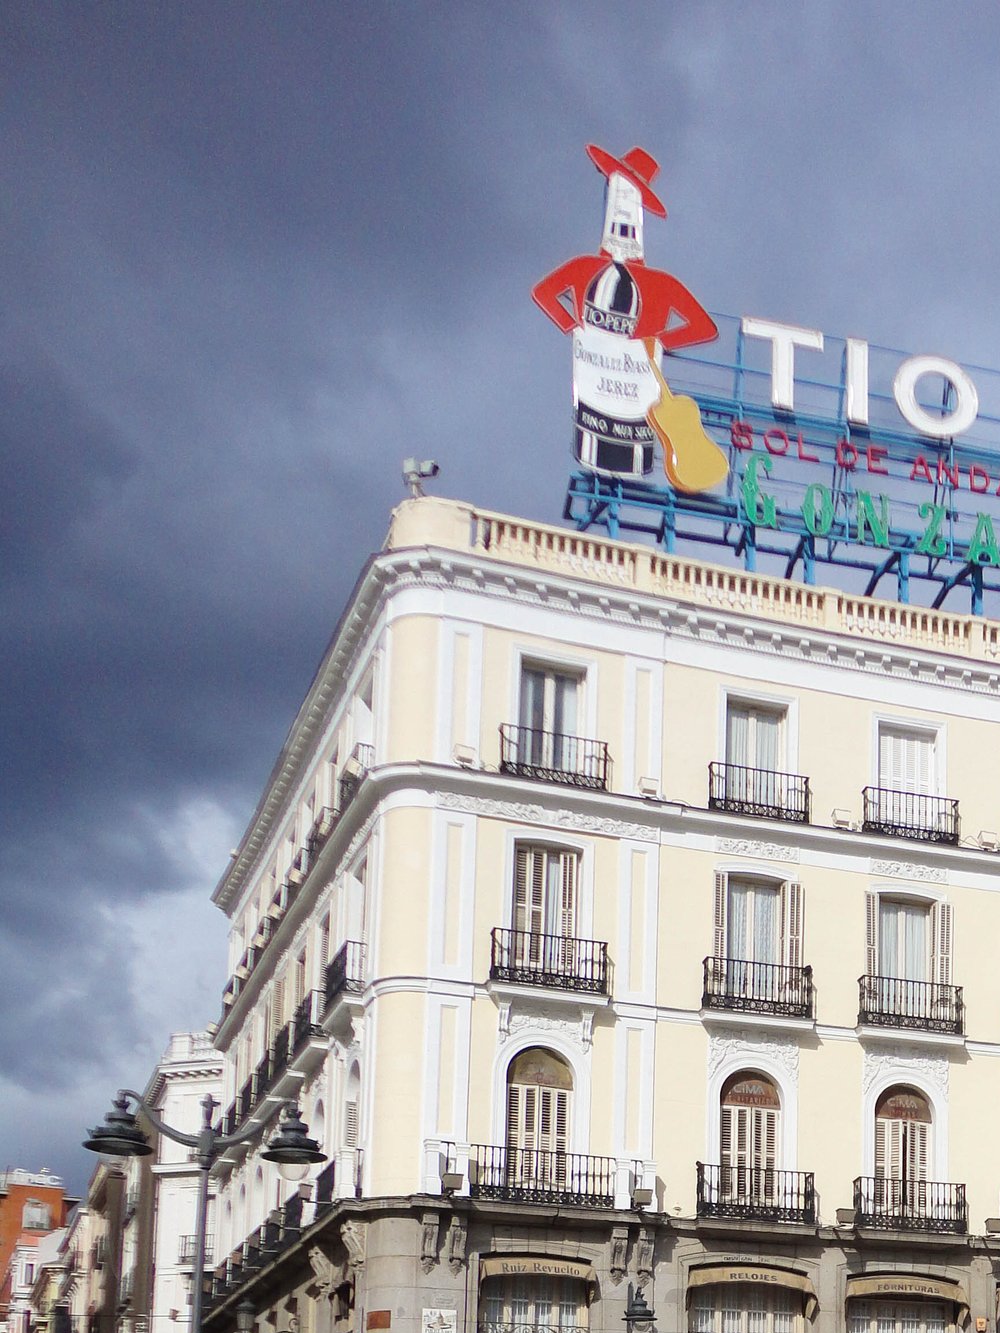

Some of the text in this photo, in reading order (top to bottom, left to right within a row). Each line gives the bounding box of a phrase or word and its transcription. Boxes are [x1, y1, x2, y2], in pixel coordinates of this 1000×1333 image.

[597, 376, 639, 398] JEREZ
[741, 316, 979, 437] TIO
[582, 411, 609, 433] FINO
[730, 420, 820, 463] SOL
[836, 437, 889, 475] DE
[501, 1262, 527, 1273] Ruiz
[729, 1273, 778, 1282] RELOJES
[877, 1284, 940, 1294] FORNITURAS
